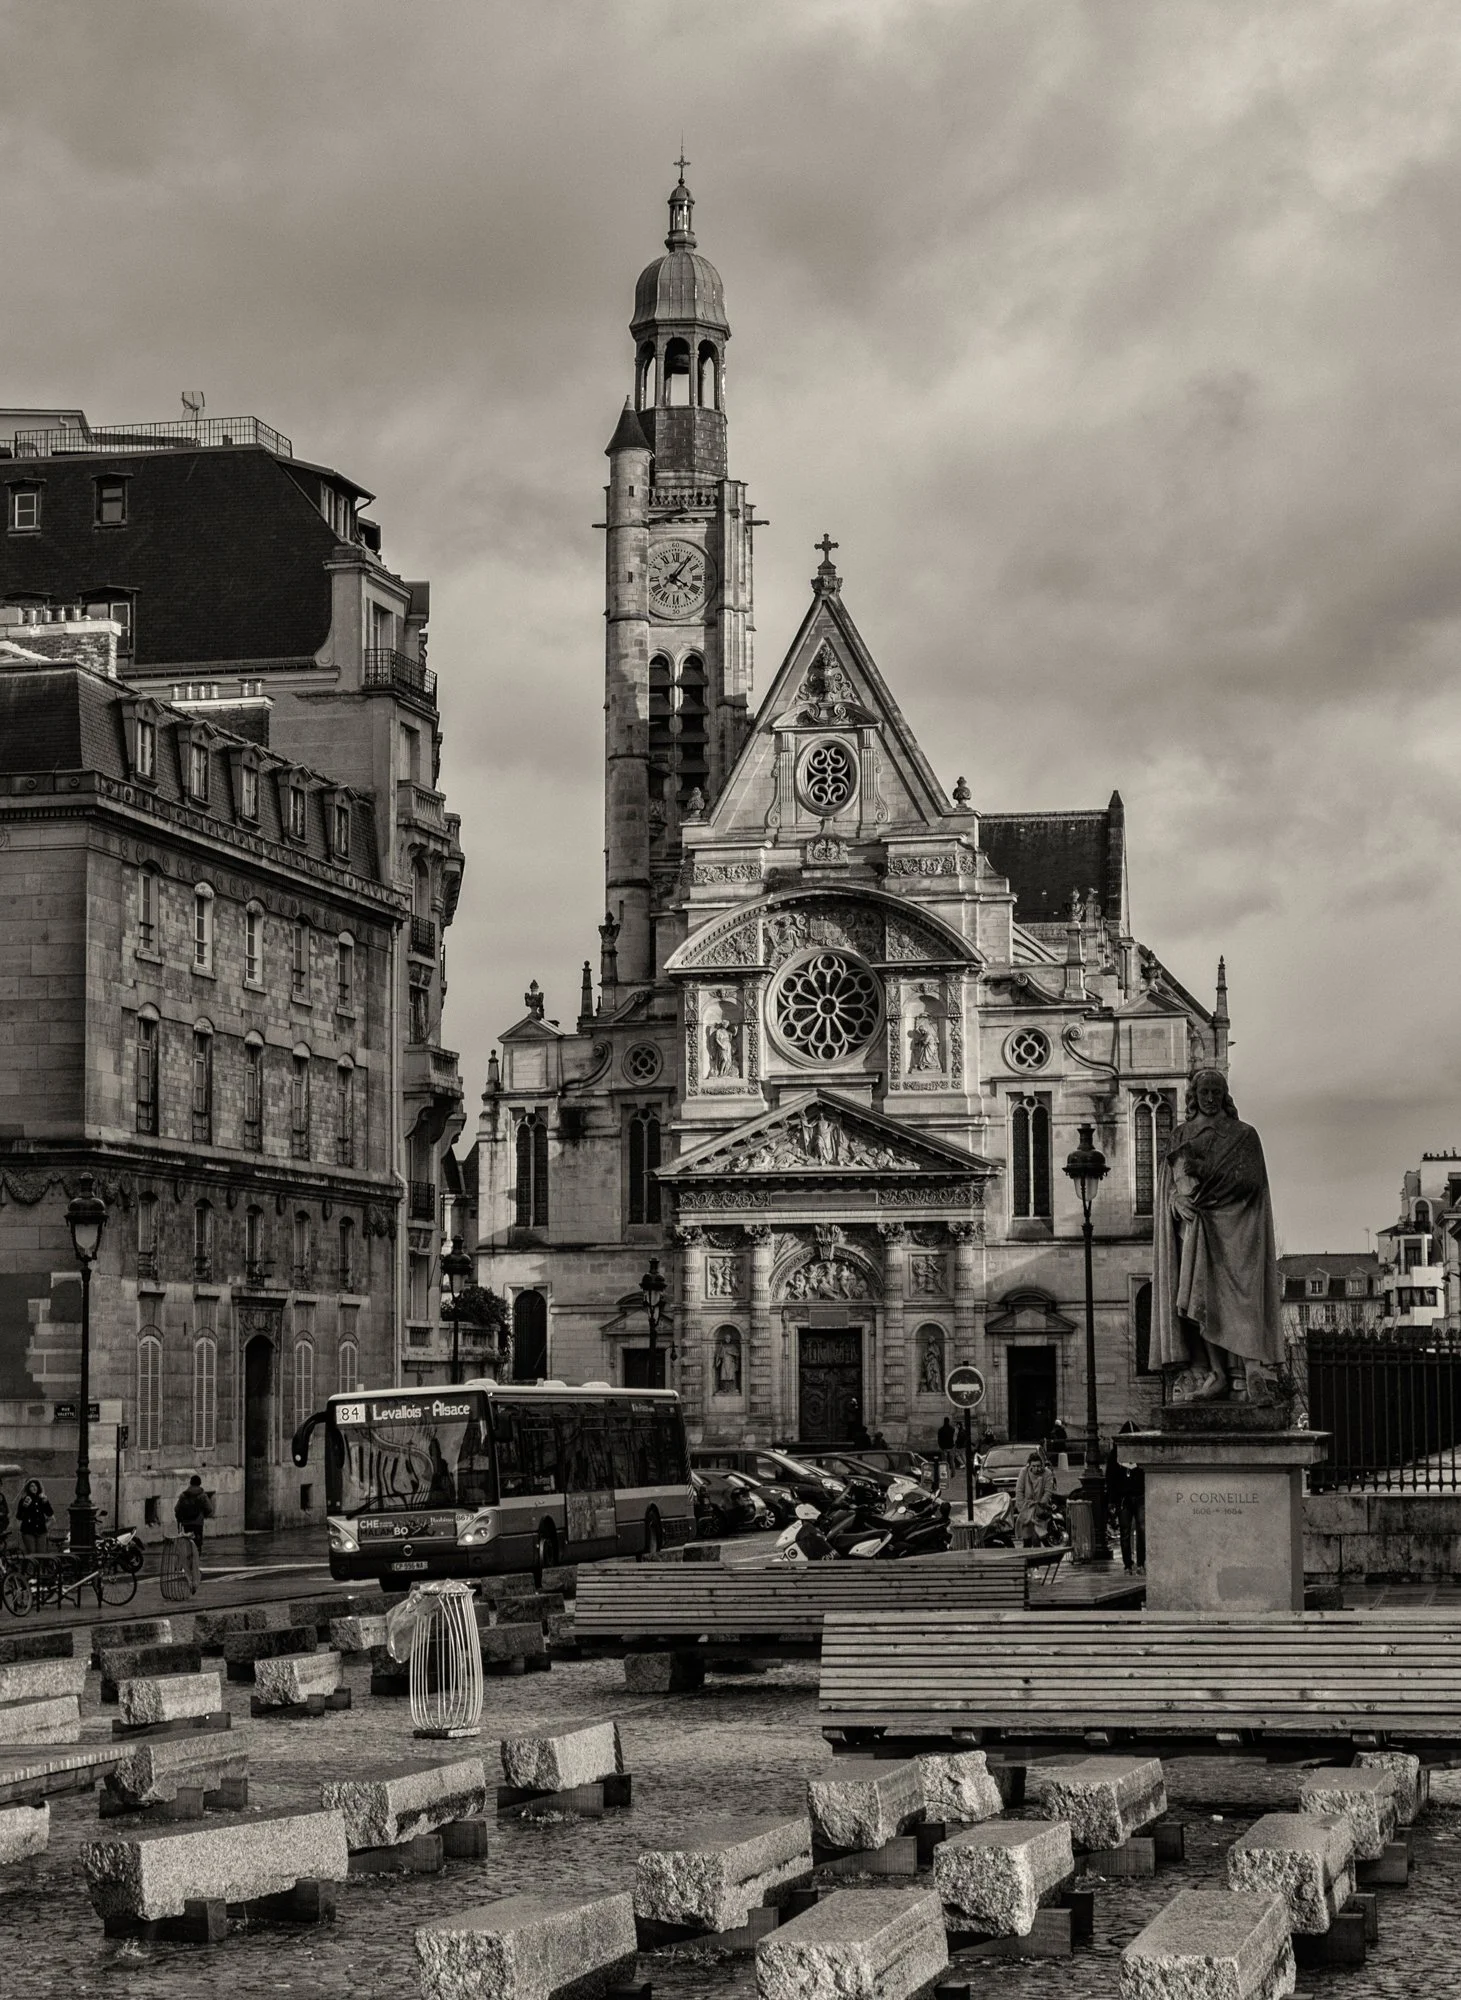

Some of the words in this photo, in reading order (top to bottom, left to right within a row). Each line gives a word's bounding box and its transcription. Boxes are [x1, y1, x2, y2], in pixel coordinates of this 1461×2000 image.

[341, 1407, 359, 1421] 84
[372, 1404, 422, 1420] Levallois
[432, 1400, 471, 1417] Alsace
[1190, 1492, 1260, 1504] CORNEILLE
[360, 1519, 379, 1529] CHE
